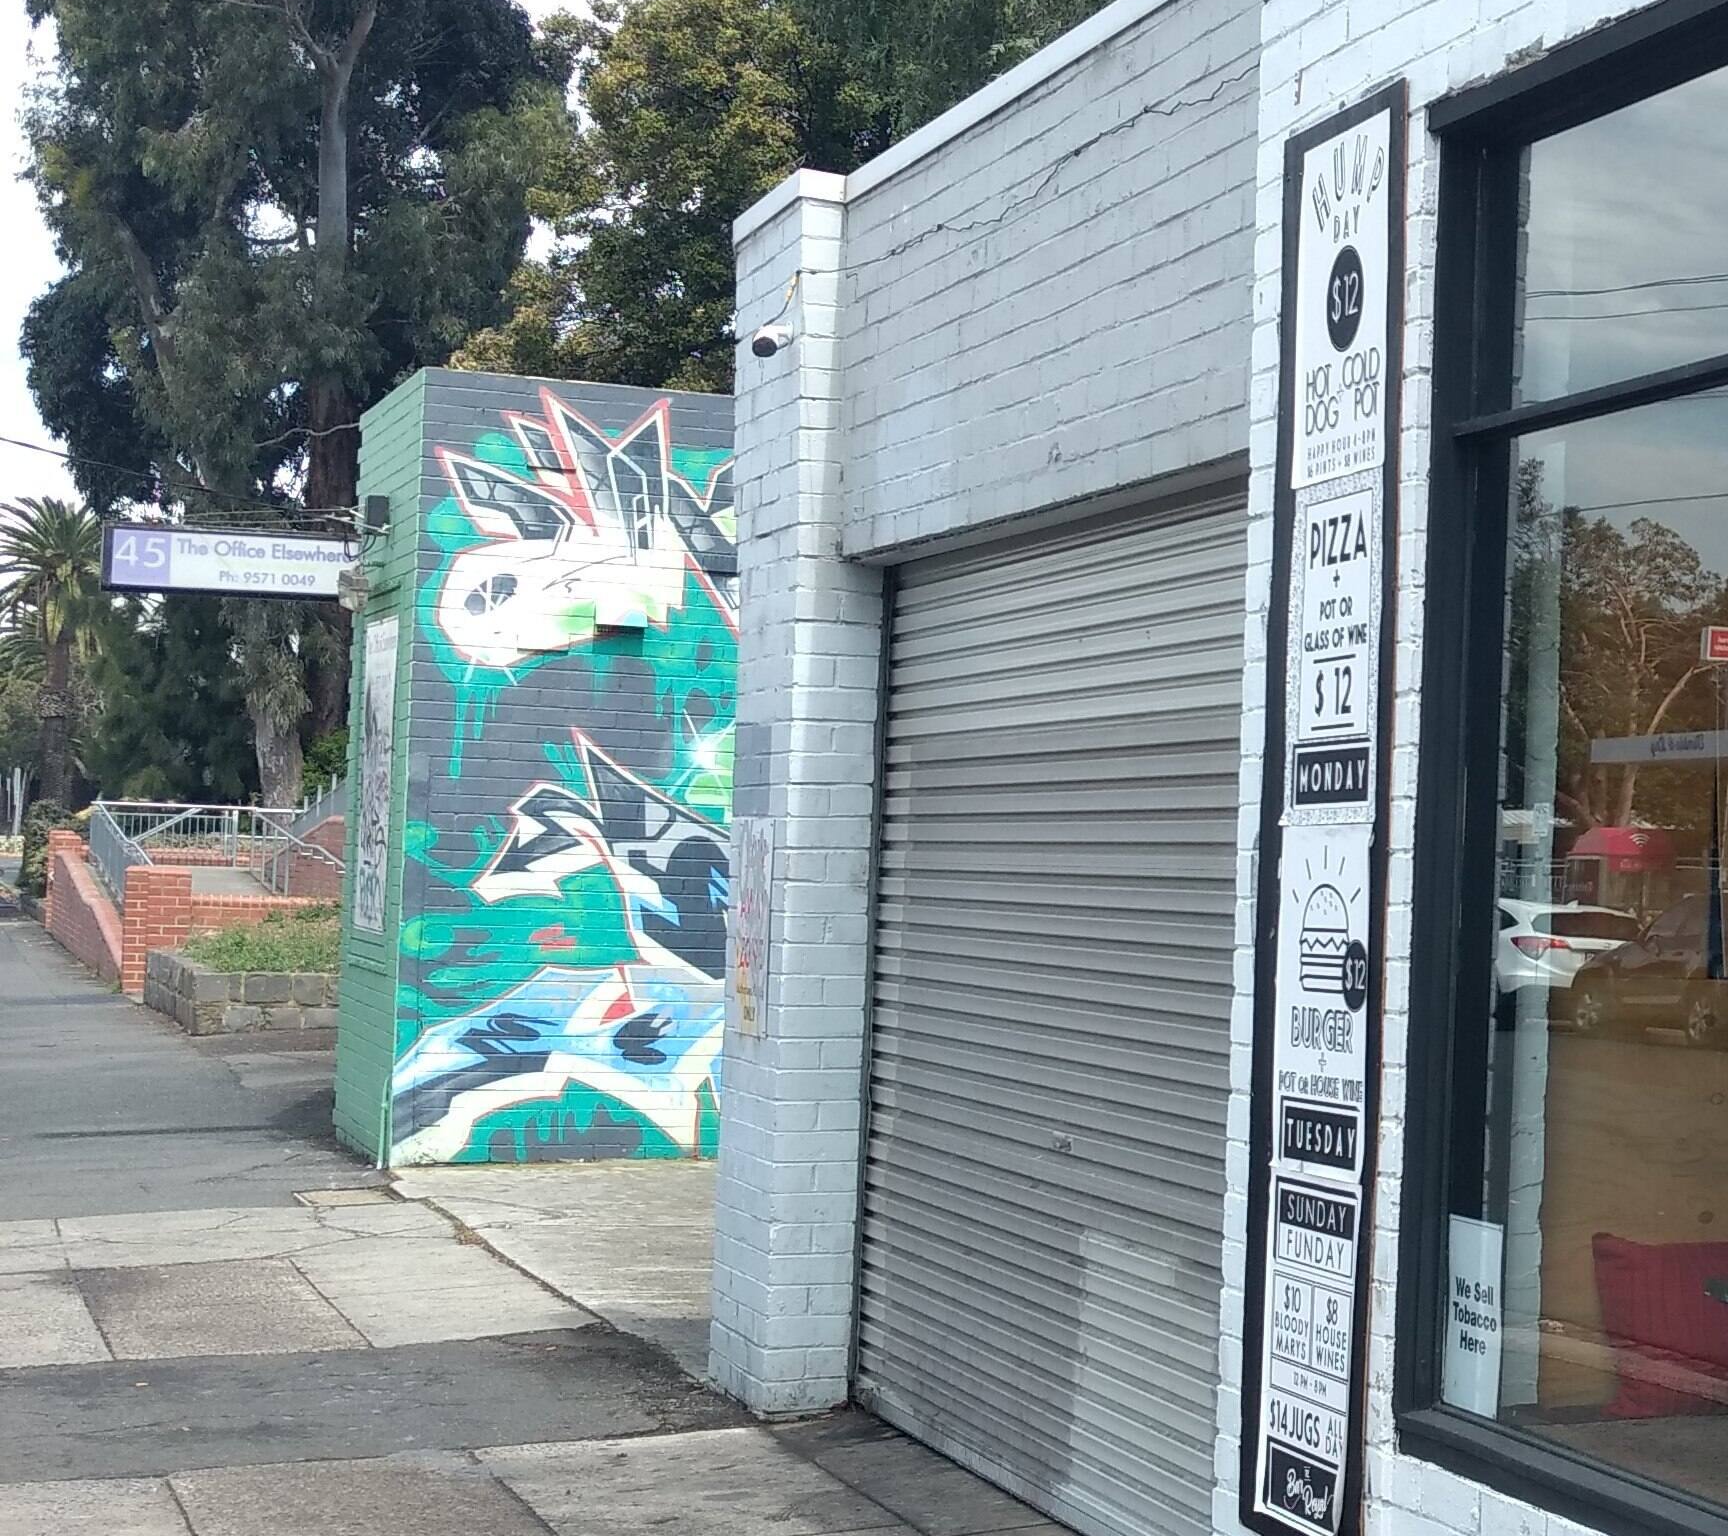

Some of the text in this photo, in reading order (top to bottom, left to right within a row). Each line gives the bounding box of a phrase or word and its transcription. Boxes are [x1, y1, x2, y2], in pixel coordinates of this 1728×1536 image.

[1312, 134, 1384, 232] HUMP
[1333, 205, 1359, 243] DAY
[1332, 271, 1359, 324] $12
[1306, 347, 1380, 403] HOT COLD
[1305, 382, 1380, 436] DOG POT
[115, 536, 165, 567] 45
[177, 538, 352, 563] The Office Elsewhere
[1310, 510, 1367, 569] PIZZA
[219, 571, 315, 586] Ph: 9571 0049
[1319, 596, 1352, 621] POT OR
[1304, 623, 1368, 653] GLASS OF WINE
[1300, 759, 1366, 793] MONDAY
[1346, 959, 1366, 990] $12
[1291, 1006, 1354, 1054] BURGER
[1278, 1070, 1296, 1092] POT
[1310, 1074, 1340, 1099] HOUSE
[1342, 1079, 1364, 1102] WINE
[1287, 1118, 1356, 1160] TUESDAY
[1287, 1194, 1347, 1233] SUNDAY
[1287, 1230, 1344, 1269] FUNDAY
[1284, 1283, 1301, 1313] $10
[1456, 1276, 1493, 1306] We Sell
[1275, 1311, 1308, 1337] BLOODY
[1327, 1296, 1338, 1325] $8
[1453, 1302, 1496, 1332] Tobacco
[1276, 1331, 1306, 1360] MARYS
[1316, 1324, 1346, 1350] HOUSE
[1460, 1329, 1486, 1355] Here
[1317, 1345, 1344, 1372] WINES
[1327, 1416, 1342, 1440] ALL
